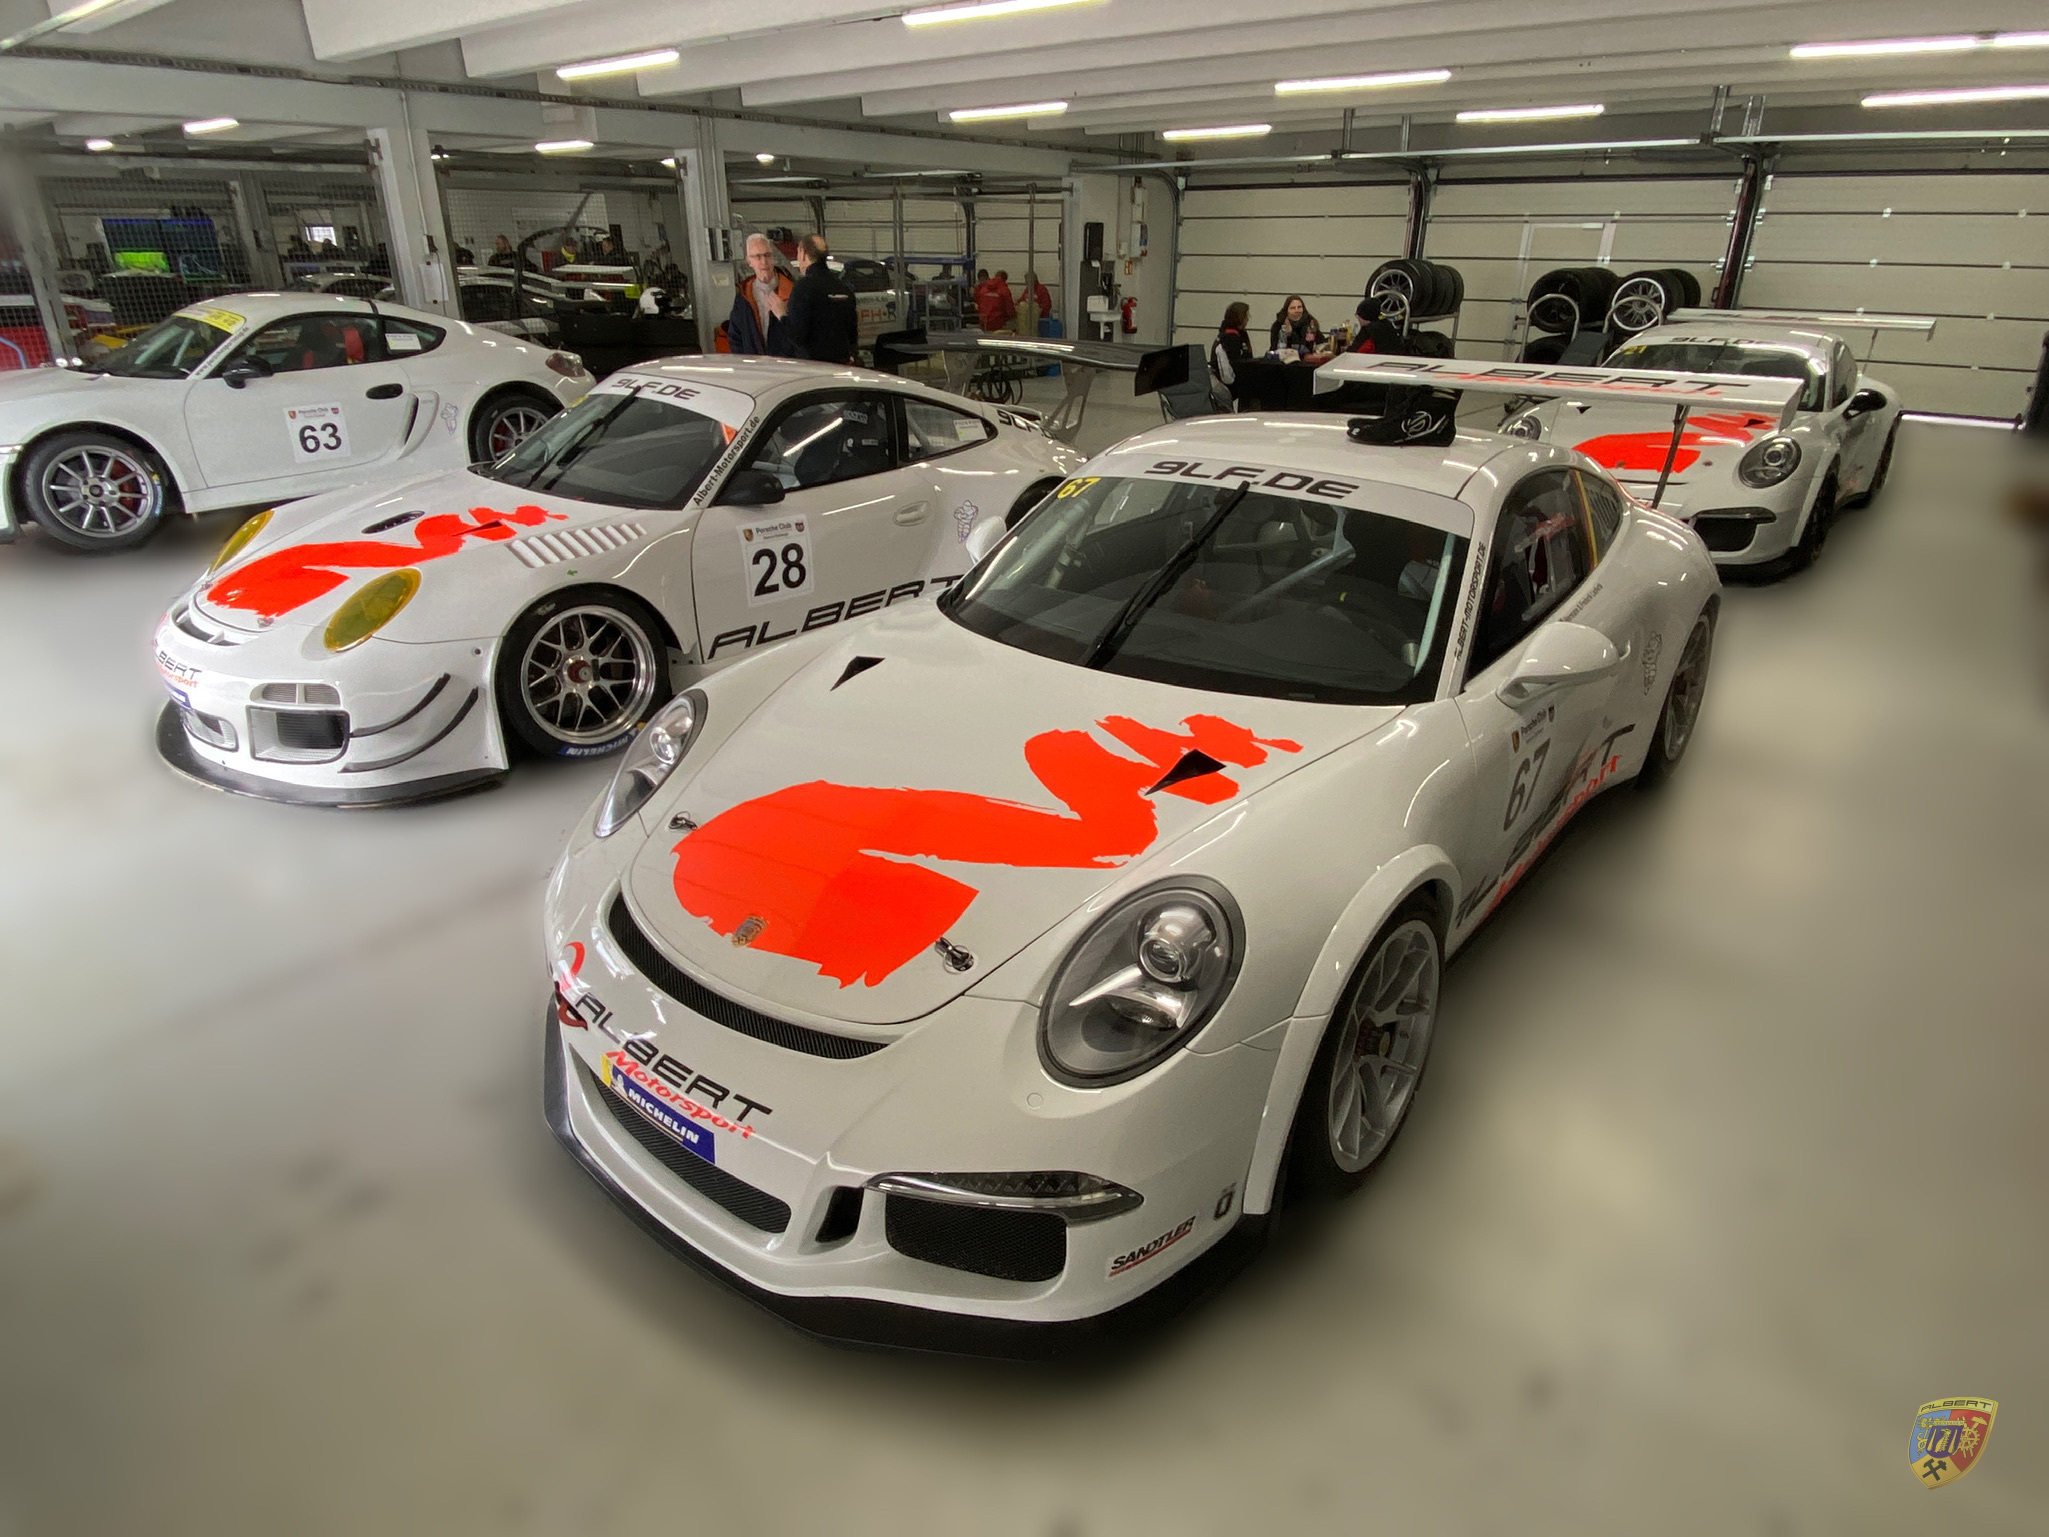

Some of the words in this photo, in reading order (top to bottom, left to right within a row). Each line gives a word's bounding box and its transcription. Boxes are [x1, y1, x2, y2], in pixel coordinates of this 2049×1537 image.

[611, 378, 701, 400] 9LF.DE
[1366, 361, 1751, 392] ALBERT
[299, 423, 342, 454] 63
[693, 416, 761, 506] Albert-Motorsport.de
[1057, 477, 1101, 499] 67
[1144, 461, 1359, 499] 9LF.DE
[779, 522, 792, 530] Club
[752, 543, 806, 597] 28
[1454, 541, 1486, 662] ALBERT-MOTORSPORT.DE
[1503, 738, 1551, 832] 67
[575, 992, 774, 1122] ALBERT
[604, 1050, 756, 1140] Motorsport
[628, 1087, 700, 1144] MICHELIN
[1110, 1216, 1197, 1270] SANDTLER
